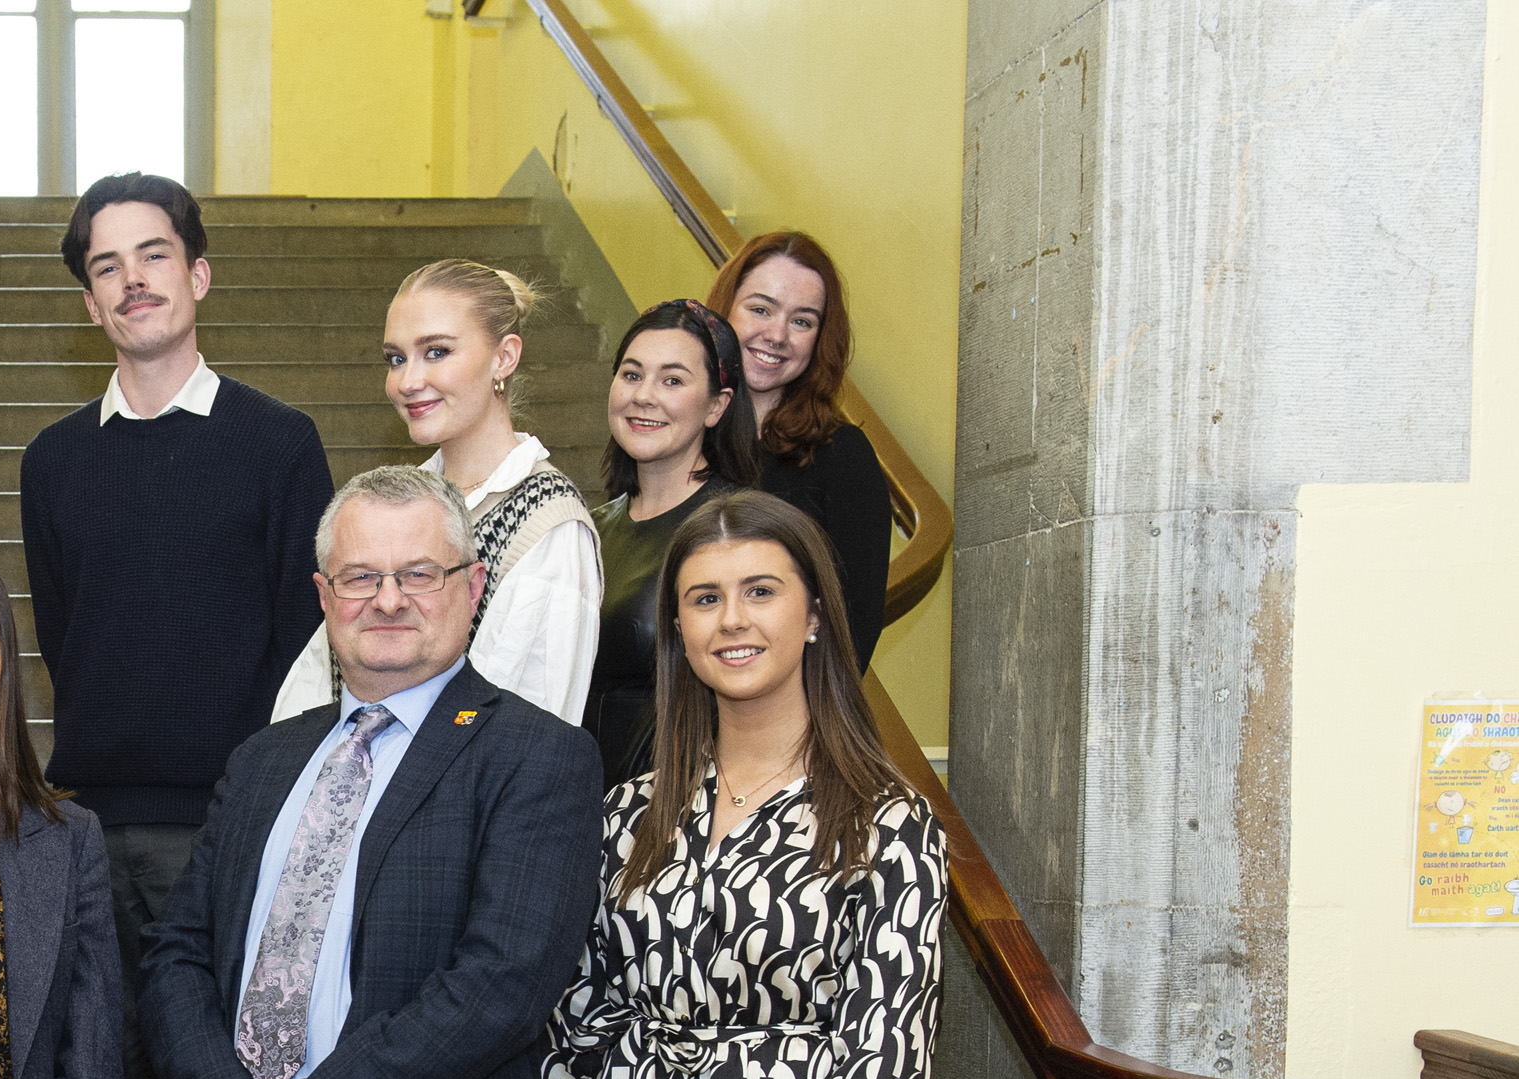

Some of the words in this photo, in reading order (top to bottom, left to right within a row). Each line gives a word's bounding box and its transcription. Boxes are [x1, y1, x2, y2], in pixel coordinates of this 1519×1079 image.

[1486, 713, 1500, 724] DO
[1487, 824, 1504, 832] Caith
[1423, 861, 1449, 869] casacht
[1419, 875, 1433, 886] Go
[1437, 873, 1469, 885] raibh
[1431, 884, 1464, 896] maith
[1468, 881, 1501, 897] agat!
